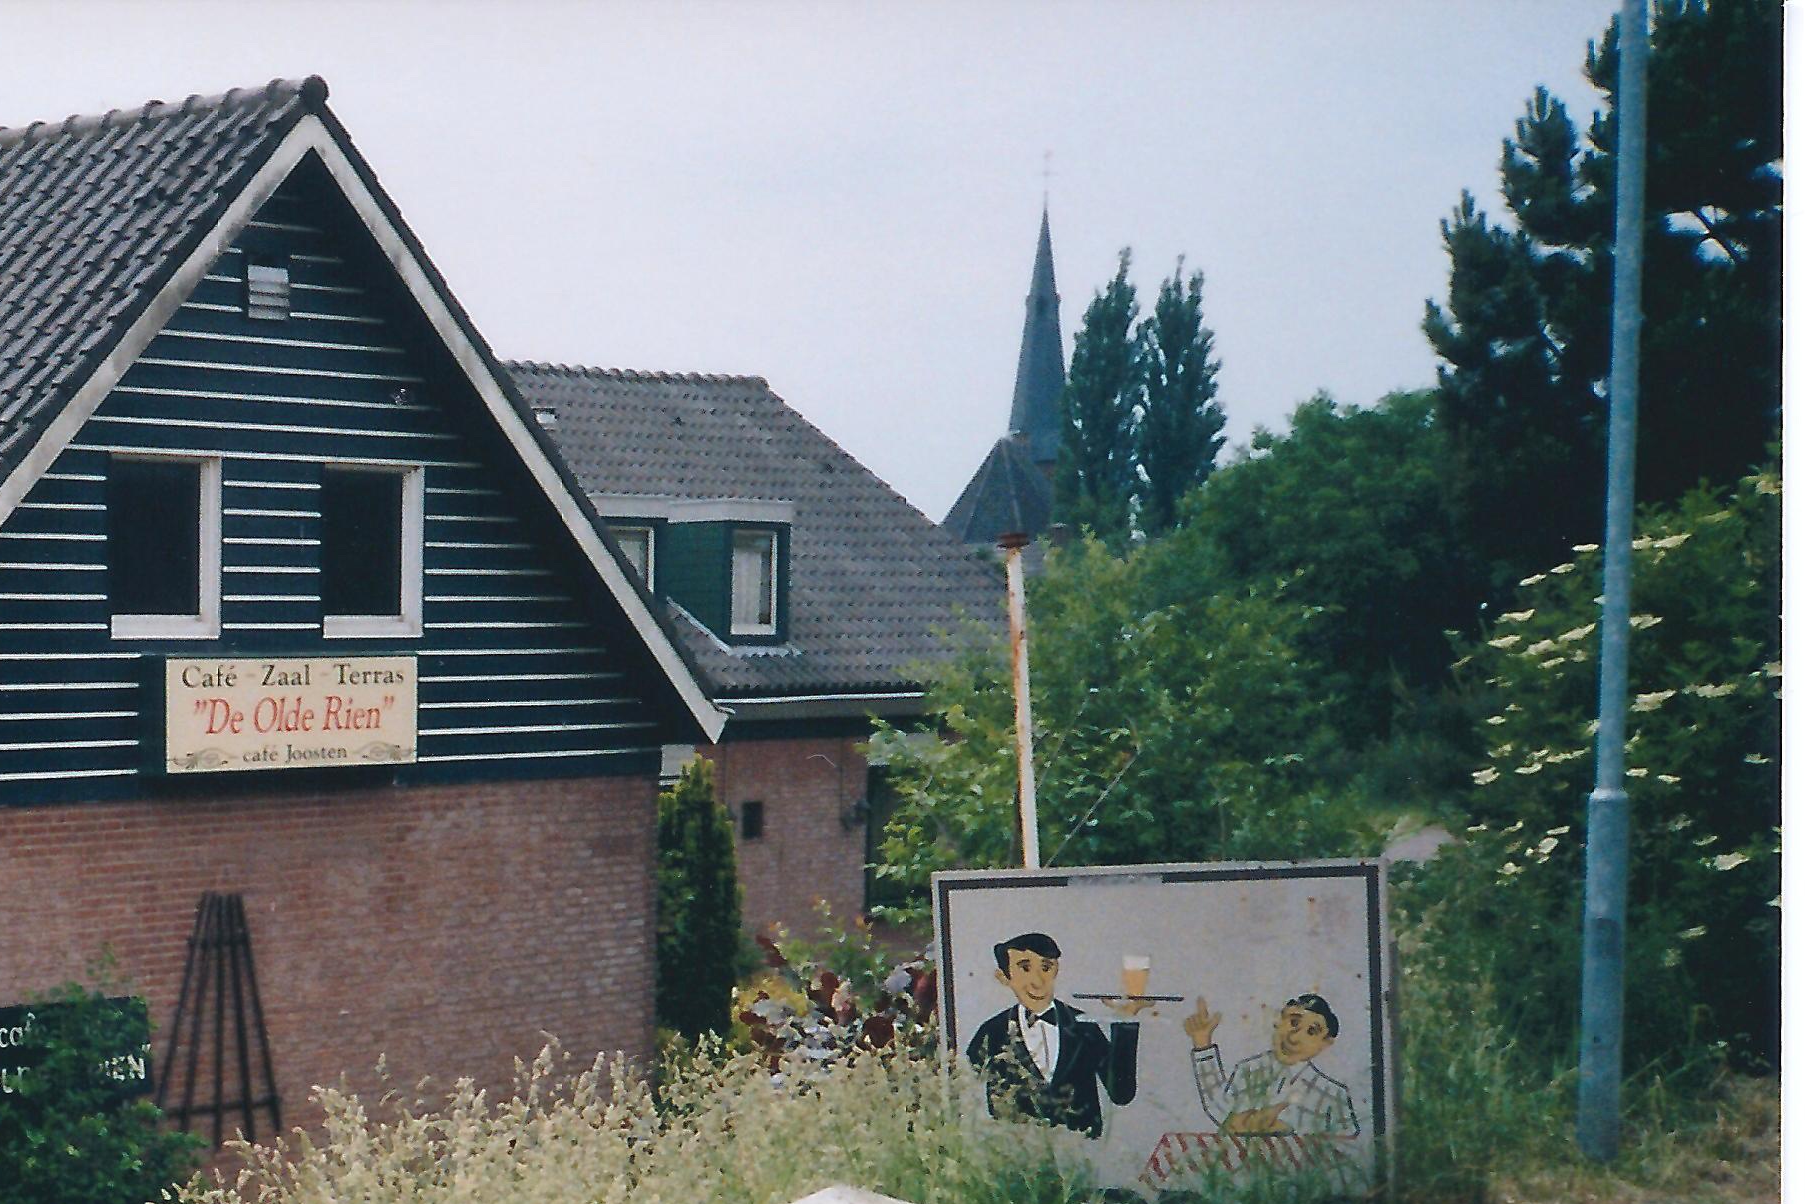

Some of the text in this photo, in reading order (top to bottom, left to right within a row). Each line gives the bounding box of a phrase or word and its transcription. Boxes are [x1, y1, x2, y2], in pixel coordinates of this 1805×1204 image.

[181, 664, 238, 688] Café
[261, 663, 311, 687] Zaal
[333, 662, 405, 686] Terras
[252, 696, 315, 734] Olde
[242, 743, 348, 765] café Joosten
